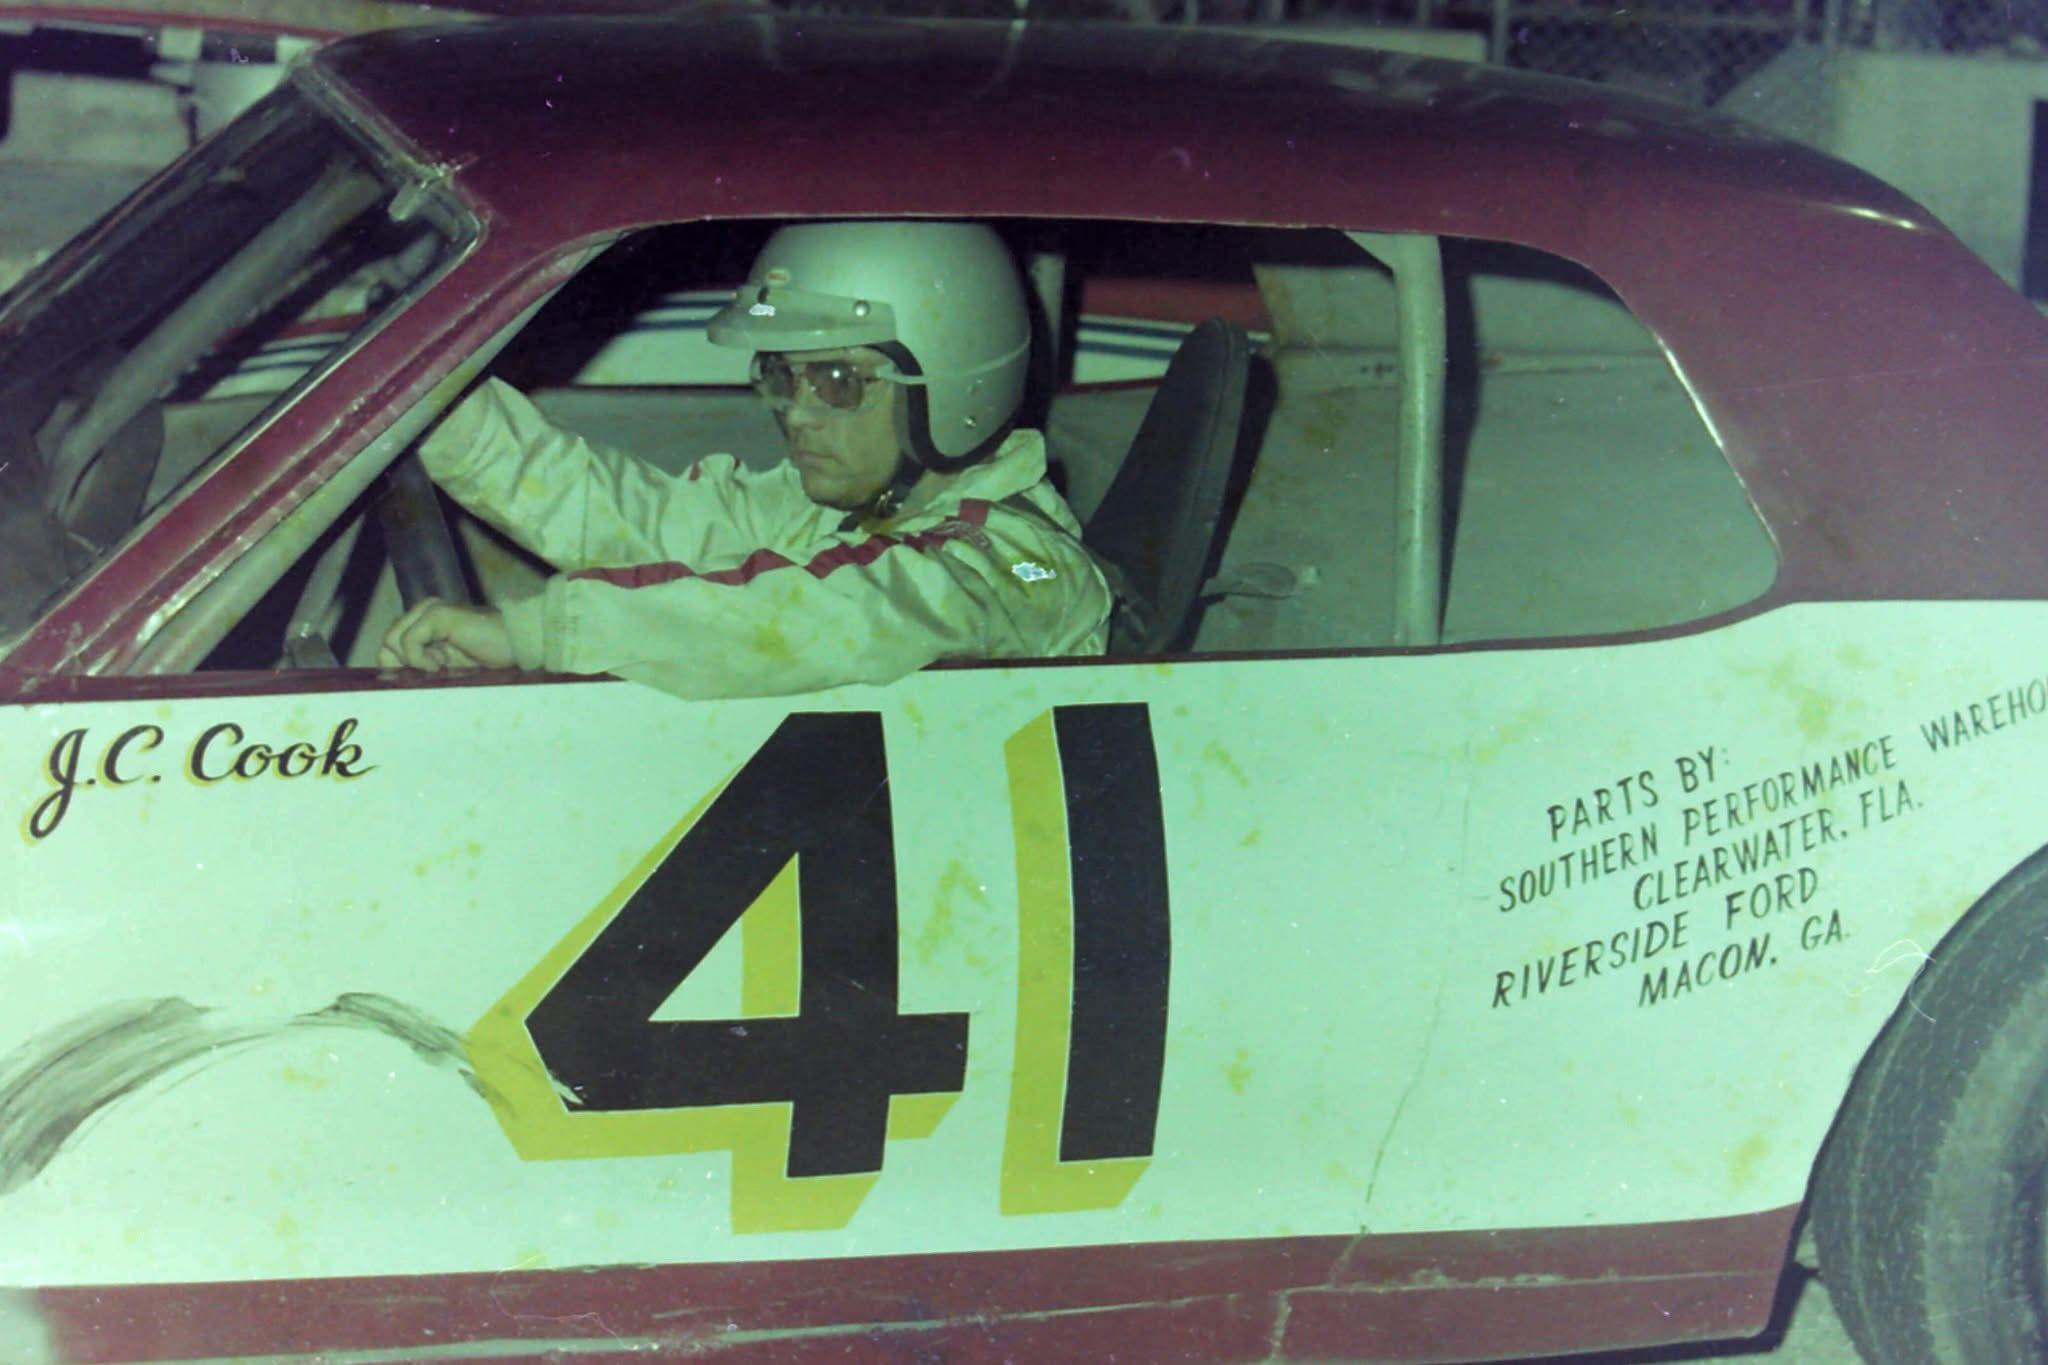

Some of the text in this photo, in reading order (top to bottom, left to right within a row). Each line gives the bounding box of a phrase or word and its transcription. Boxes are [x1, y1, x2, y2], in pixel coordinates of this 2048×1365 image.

[28, 718, 380, 840] J.C. Cook
[1499, 676, 2048, 913] SOUTHERN PERFORMANCE WAREHO
[1547, 746, 1731, 843] PARTS BY:
[1859, 778, 1924, 829] FLA.
[524, 702, 1172, 1179] 41
[1491, 866, 1818, 1008] RIVERSIDE FORD
